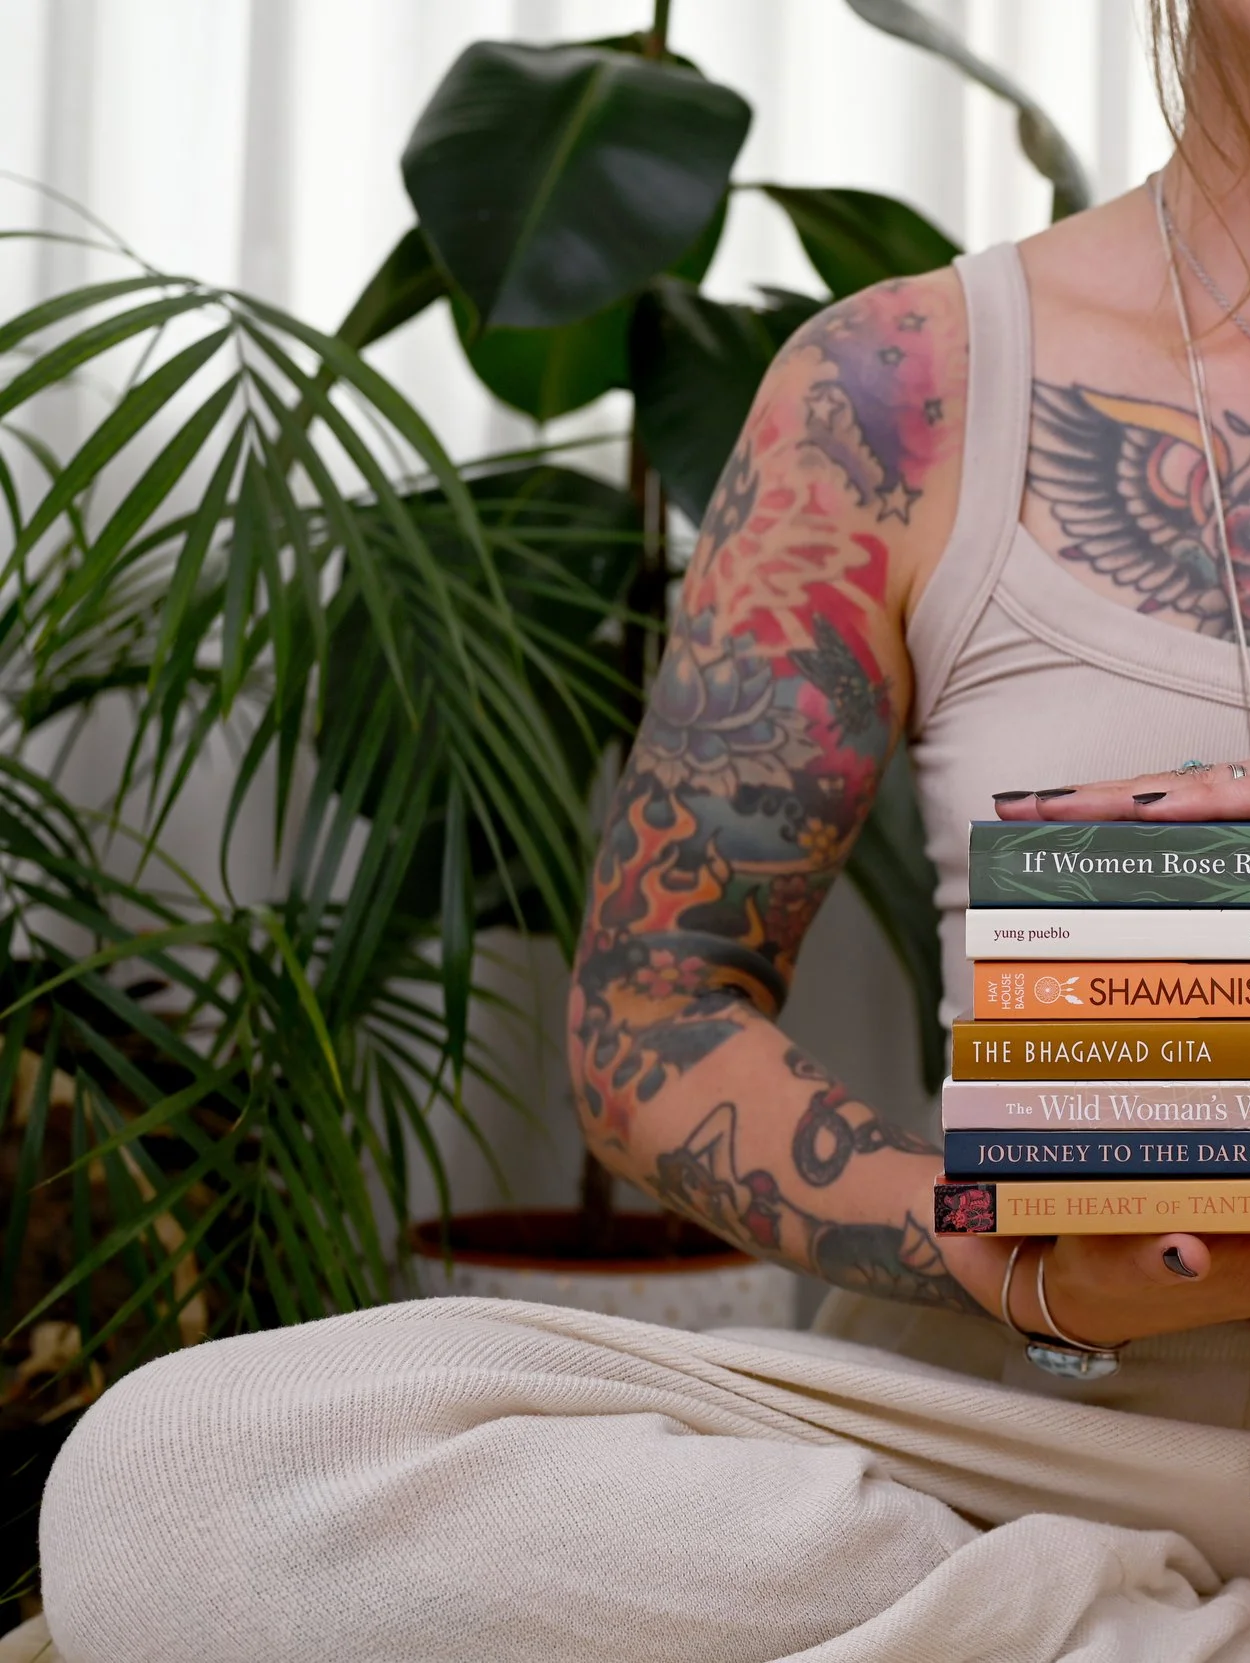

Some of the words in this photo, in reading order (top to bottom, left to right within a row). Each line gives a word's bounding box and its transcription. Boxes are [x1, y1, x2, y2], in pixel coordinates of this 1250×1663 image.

[1022, 851, 1047, 874] If
[1052, 852, 1154, 875] Women
[1161, 853, 1226, 875] Rose
[993, 929, 1024, 941] yung
[1028, 927, 1070, 941] pueblo
[988, 981, 998, 1002] HAY
[1001, 973, 1011, 1010] HOUSE
[1015, 973, 1025, 1009] BASICS
[973, 1041, 1011, 1063] THE
[1025, 1041, 1149, 1063] BHAGAVAD
[1161, 1040, 1212, 1063] GITA
[1005, 1103, 1033, 1115] The
[1039, 1094, 1100, 1121] Wild
[1109, 1095, 1227, 1121] Woman's
[977, 1144, 1091, 1166] JOURNEY
[1098, 1144, 1131, 1163] TO
[1140, 1144, 1190, 1163] THE
[1007, 1198, 1056, 1216] THE
[1067, 1197, 1148, 1216] HEART
[1156, 1200, 1182, 1215] OF
